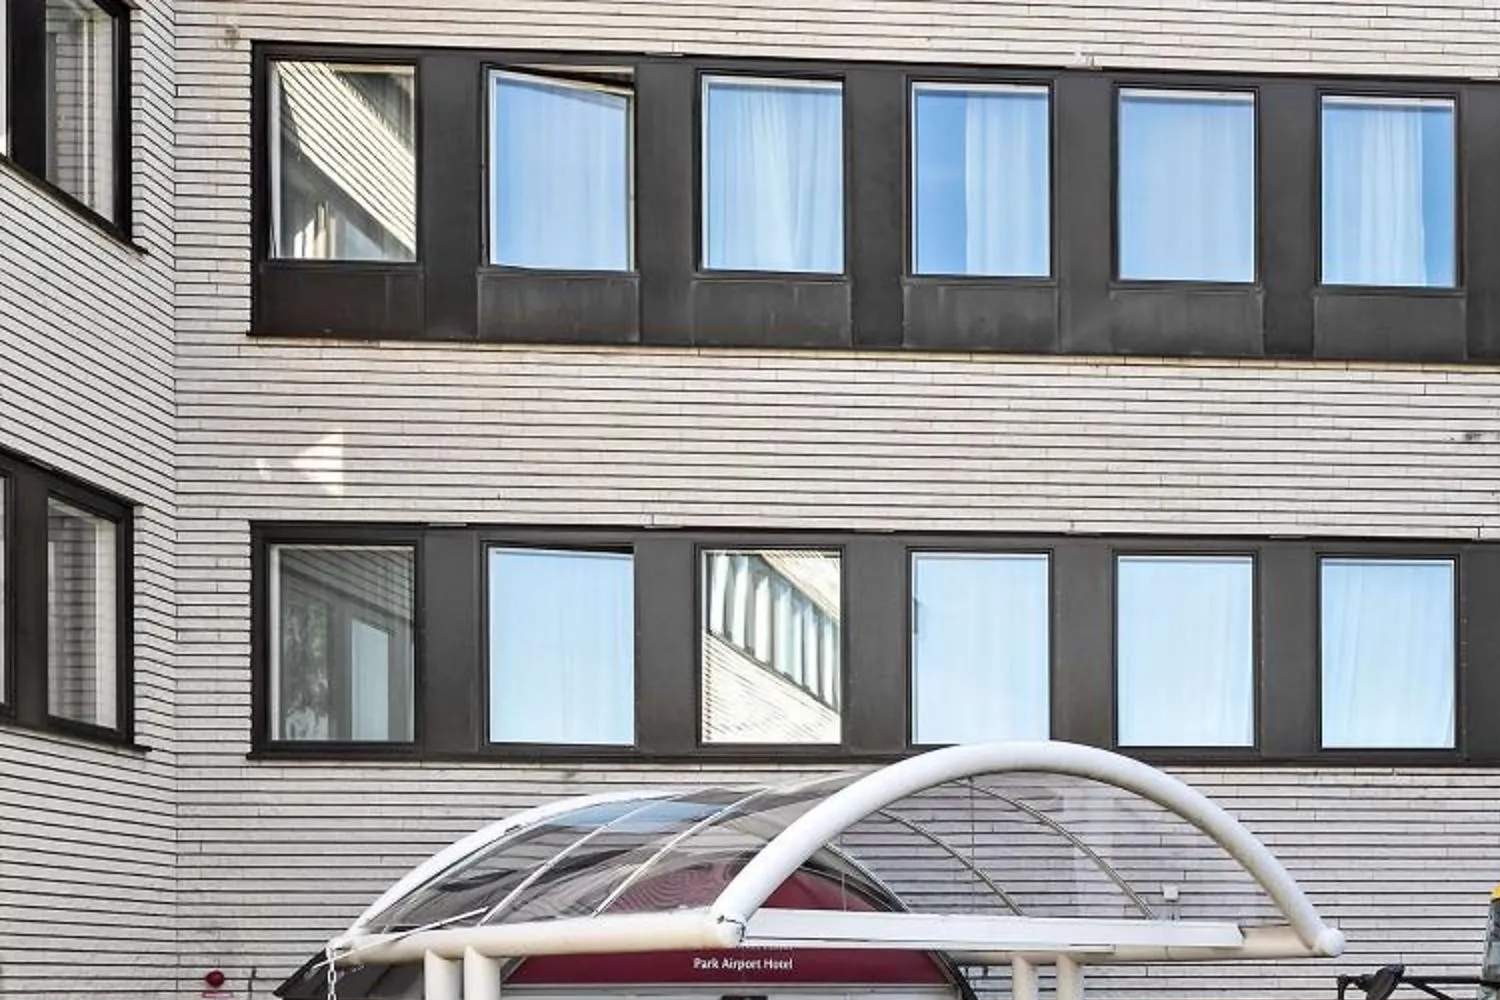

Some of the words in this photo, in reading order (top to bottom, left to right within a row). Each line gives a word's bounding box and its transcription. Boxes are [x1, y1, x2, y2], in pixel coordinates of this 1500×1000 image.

[693, 957, 719, 969] Park
[721, 957, 762, 971] Airport
[763, 957, 794, 969] Hotel
